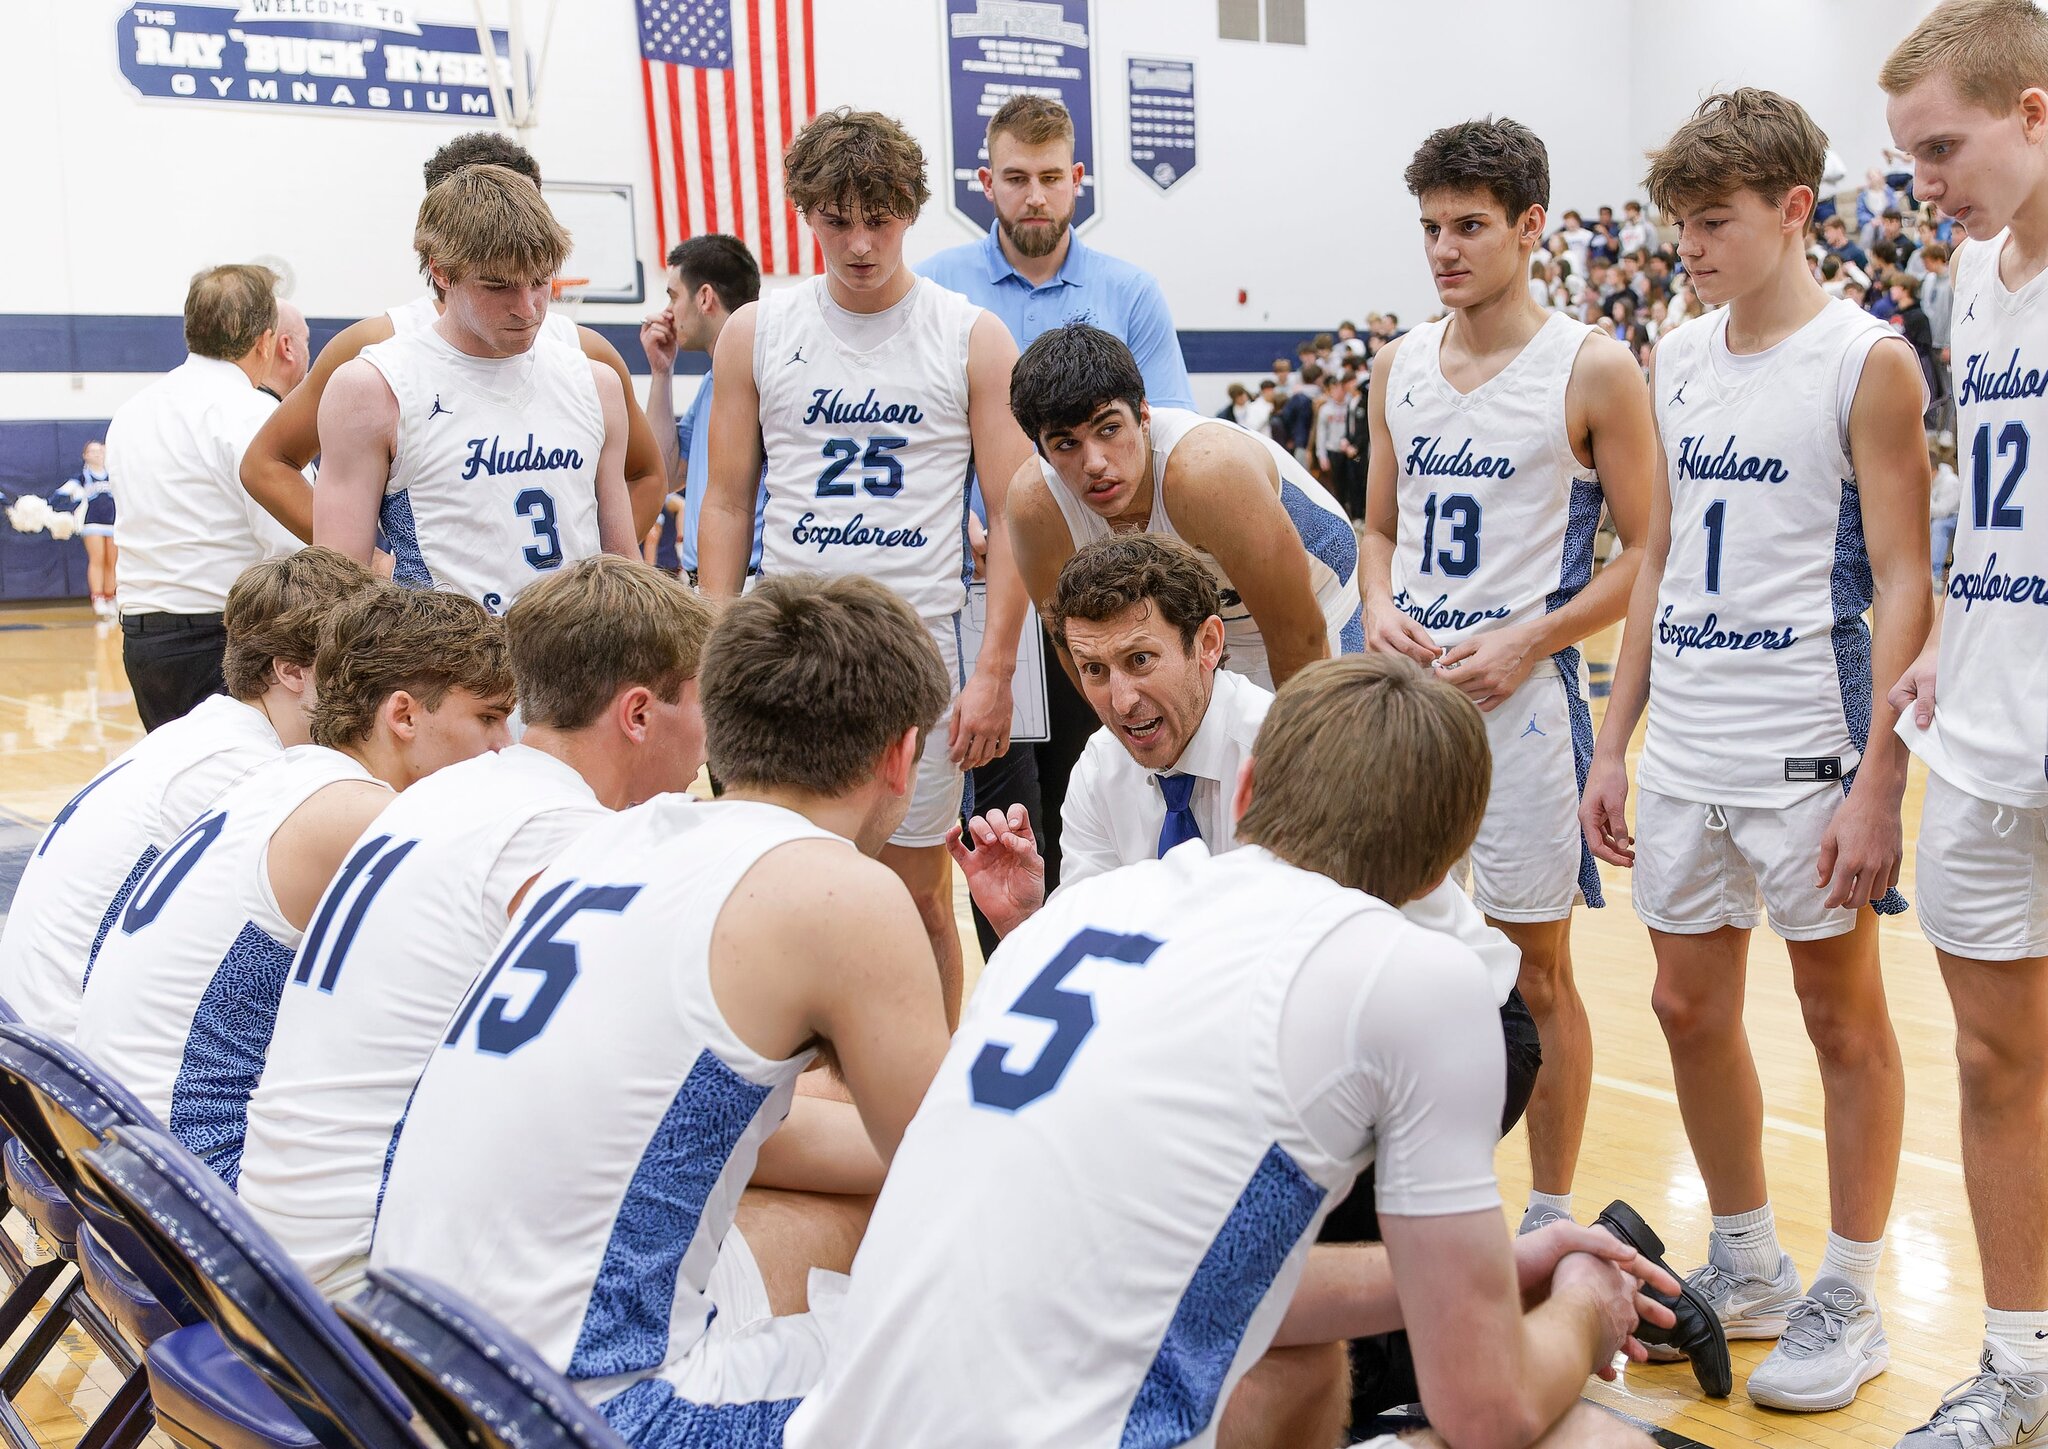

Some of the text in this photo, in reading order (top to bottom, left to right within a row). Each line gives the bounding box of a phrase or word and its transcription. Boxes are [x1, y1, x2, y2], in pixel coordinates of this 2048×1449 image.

[133, 8, 176, 26] THE
[252, 0, 404, 25] WELCOME TO
[134, 26, 226, 69] RAY
[171, 73, 490, 115] GYMNASIUM
[803, 388, 924, 425] Hudson
[461, 433, 584, 481] Hudson
[815, 436, 909, 498] 25
[1405, 436, 1516, 480] Hudson
[1677, 435, 1788, 484] Hudson
[1971, 420, 2031, 531] 12
[514, 487, 564, 572] 3
[792, 512, 928, 553] Explorers
[1419, 491, 1484, 579] 13
[1702, 499, 1727, 595] 1
[1946, 552, 2048, 612] xplorer
[1659, 605, 1799, 657] Explorers
[1824, 764, 1833, 775] S
[292, 832, 422, 995] 11
[441, 877, 647, 1059] 15
[967, 924, 1168, 1116] 5
